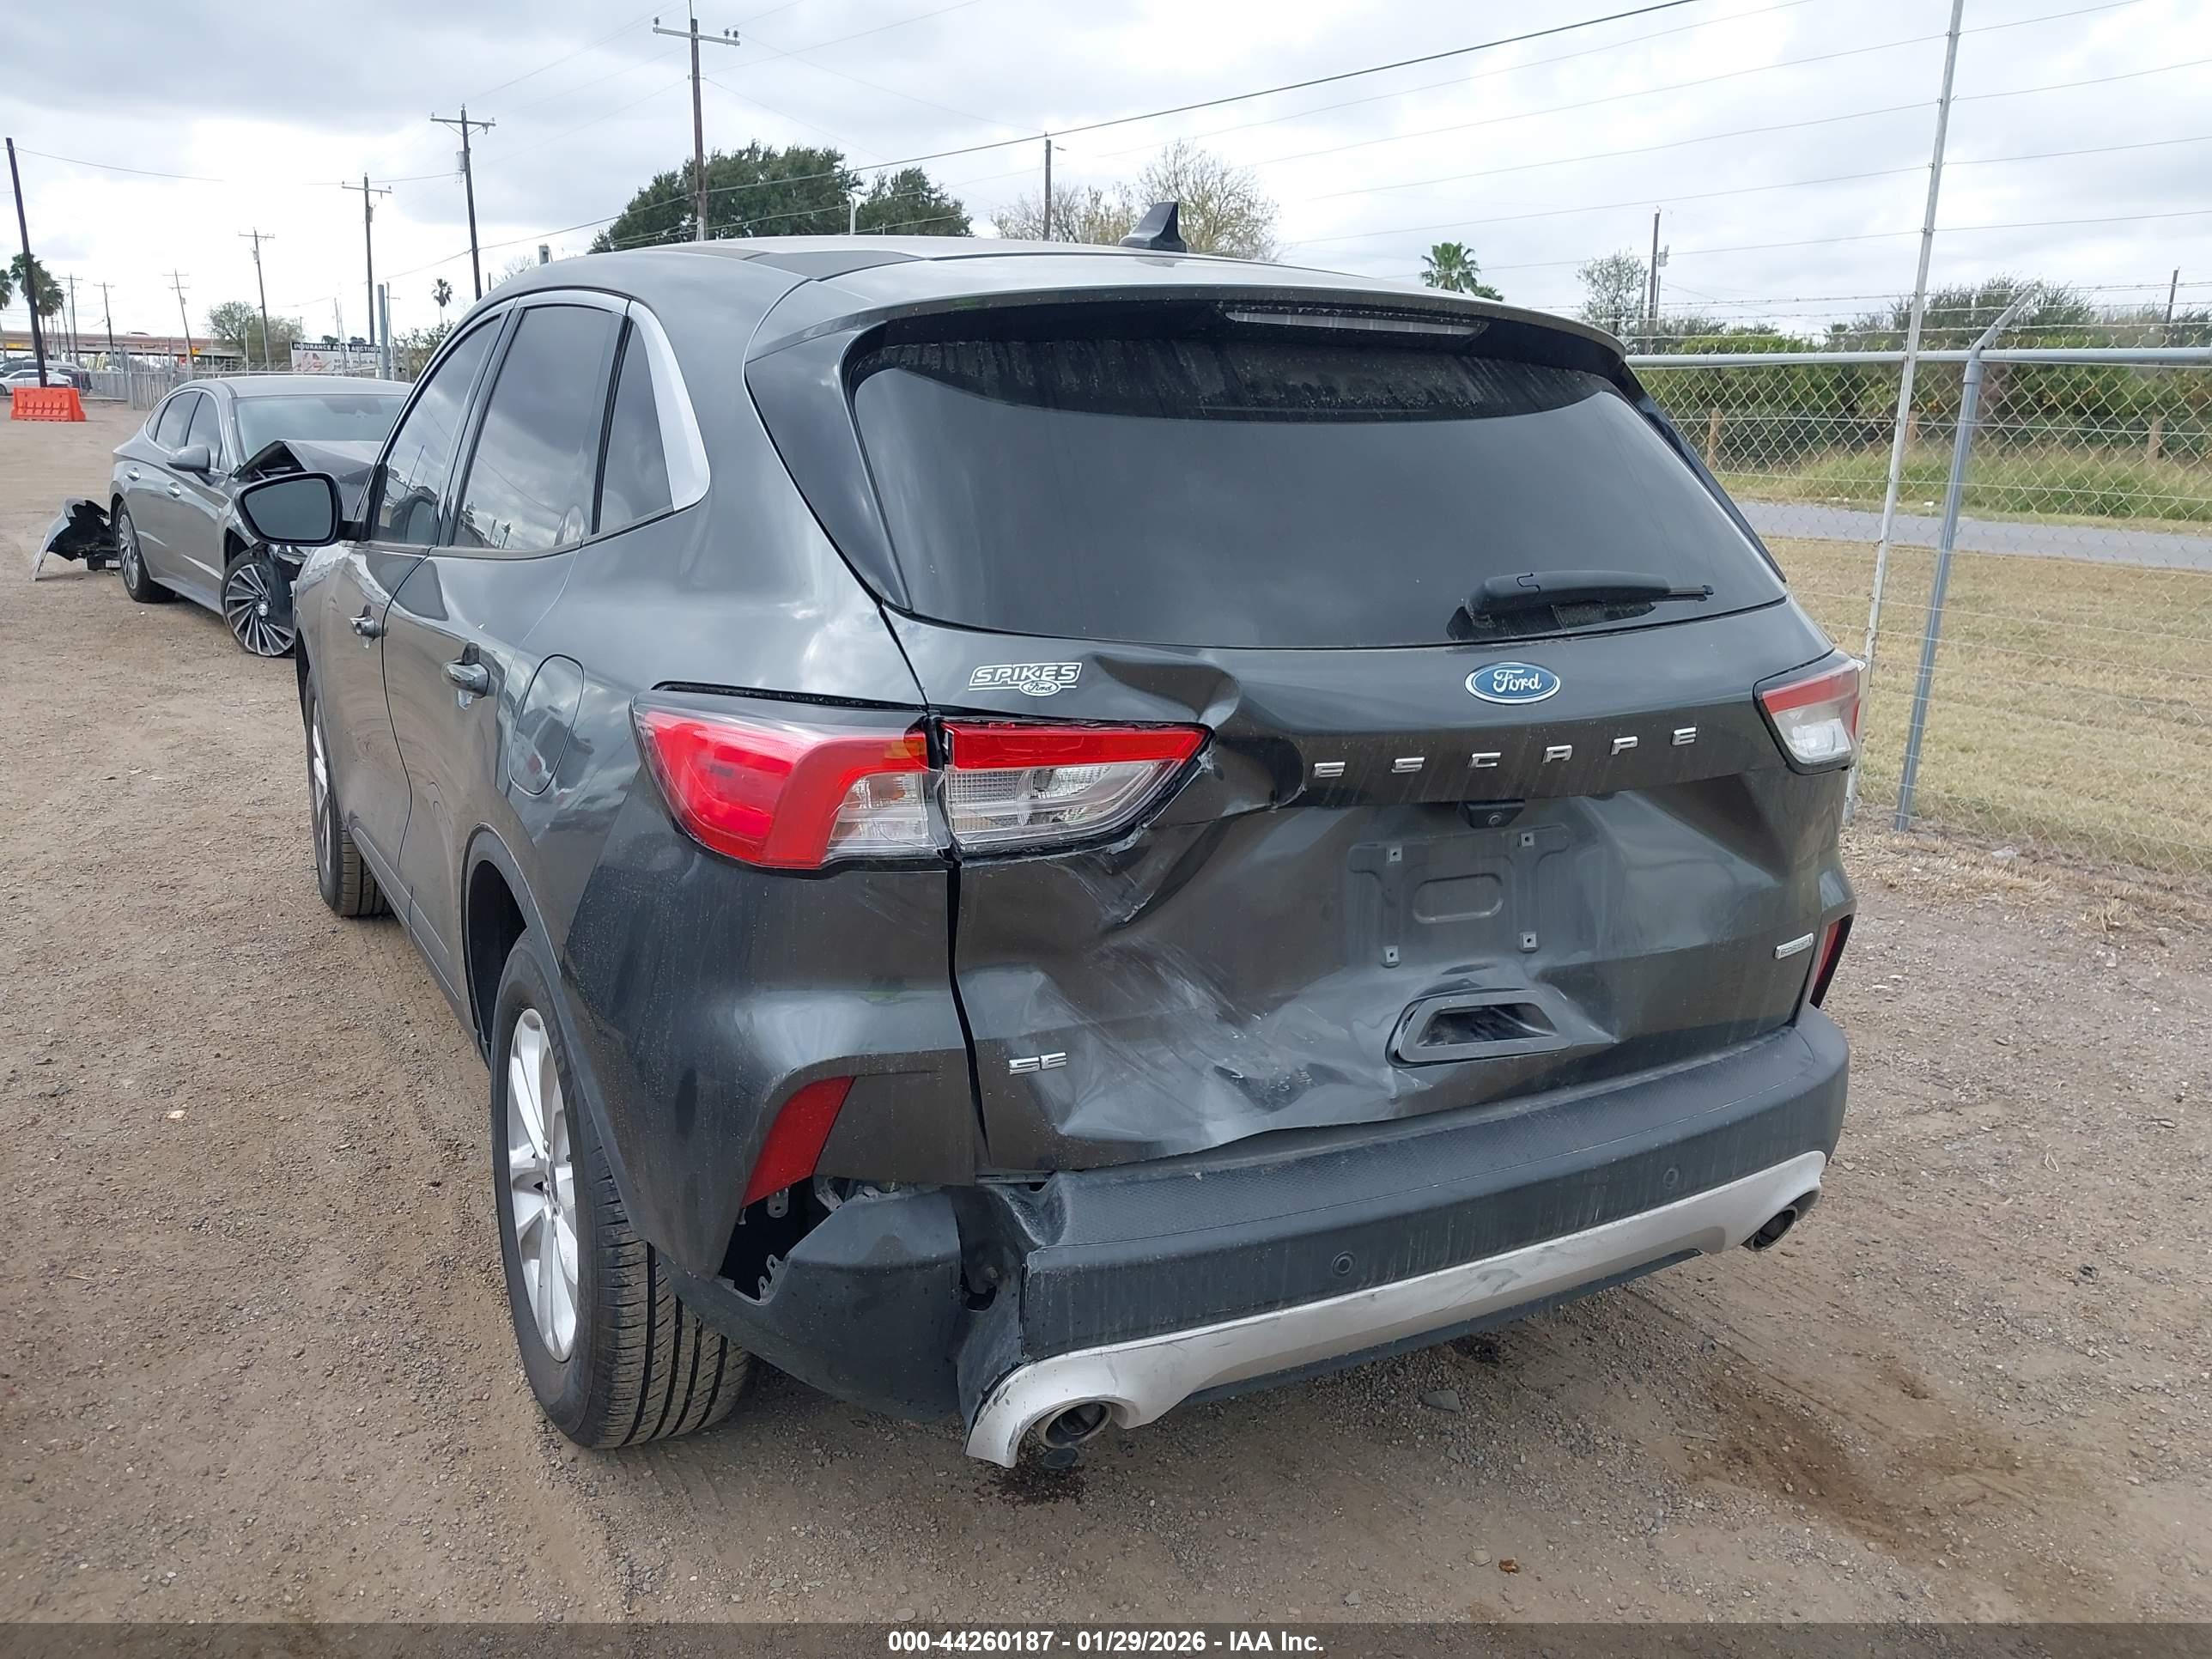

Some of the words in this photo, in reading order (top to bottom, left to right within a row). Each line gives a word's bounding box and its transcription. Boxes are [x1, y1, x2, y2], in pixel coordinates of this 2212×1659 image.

[974, 665, 1078, 683] SPIKES
[1492, 669, 1542, 693] Ford
[1312, 726, 1698, 779] ESCAPE
[1008, 1052, 1066, 1075] SE
